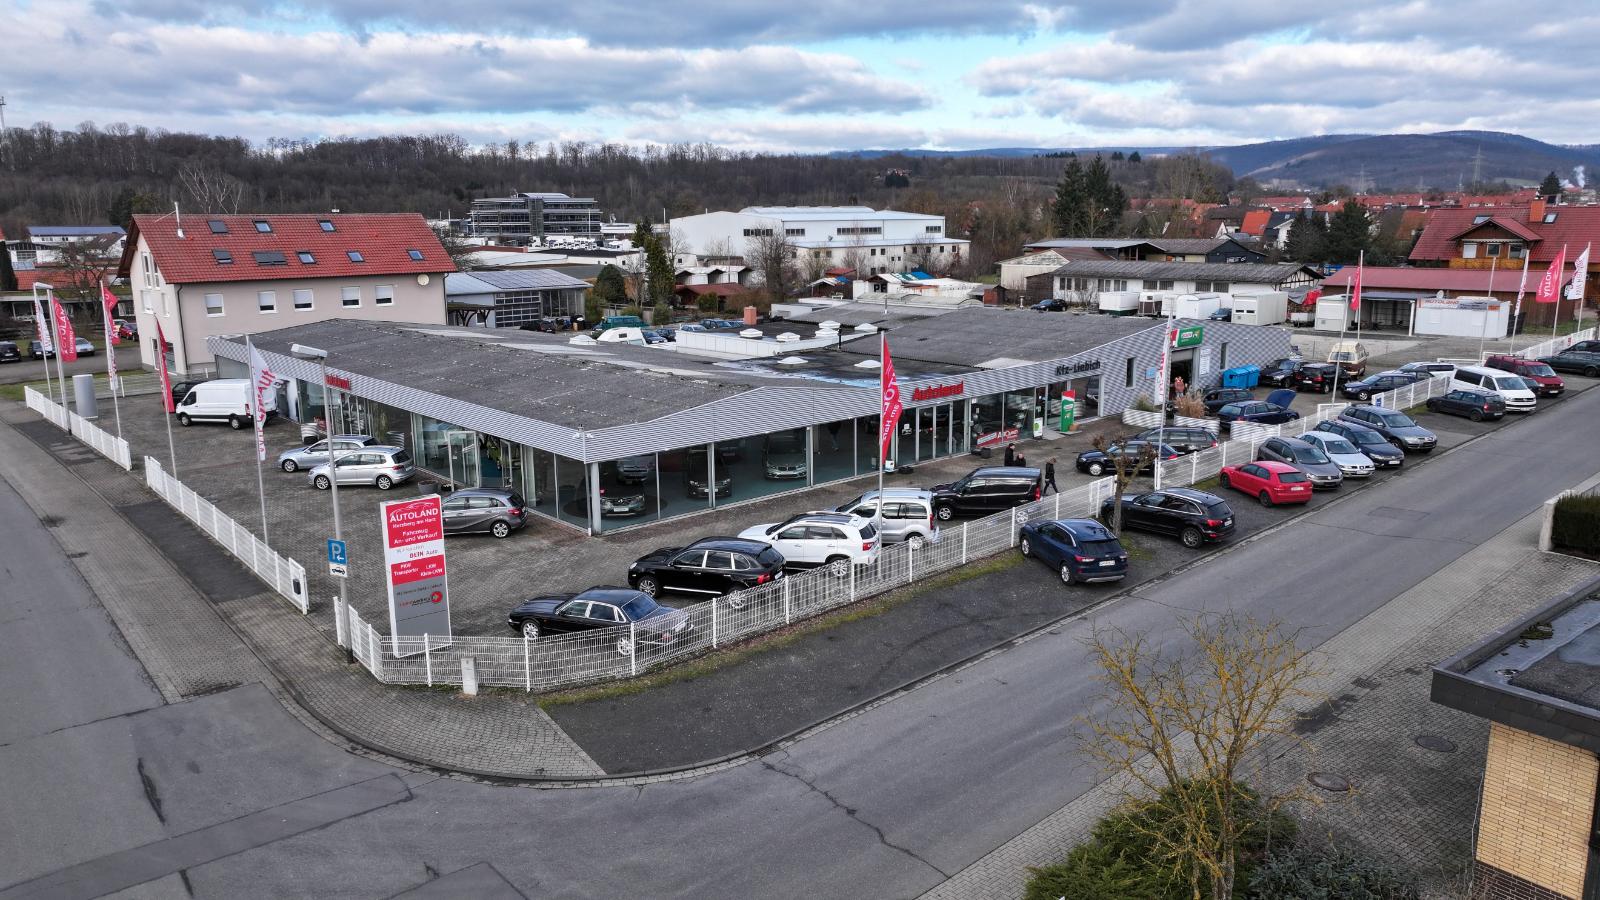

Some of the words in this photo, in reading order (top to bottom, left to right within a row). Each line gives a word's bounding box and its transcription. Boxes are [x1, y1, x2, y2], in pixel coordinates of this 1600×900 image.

[912, 381, 964, 401] Autoland
[390, 508, 439, 523] AUTOLAND
[402, 528, 429, 536] Fahrzeug
[417, 532, 438, 541] Verkauf
[332, 543, 342, 560] P
